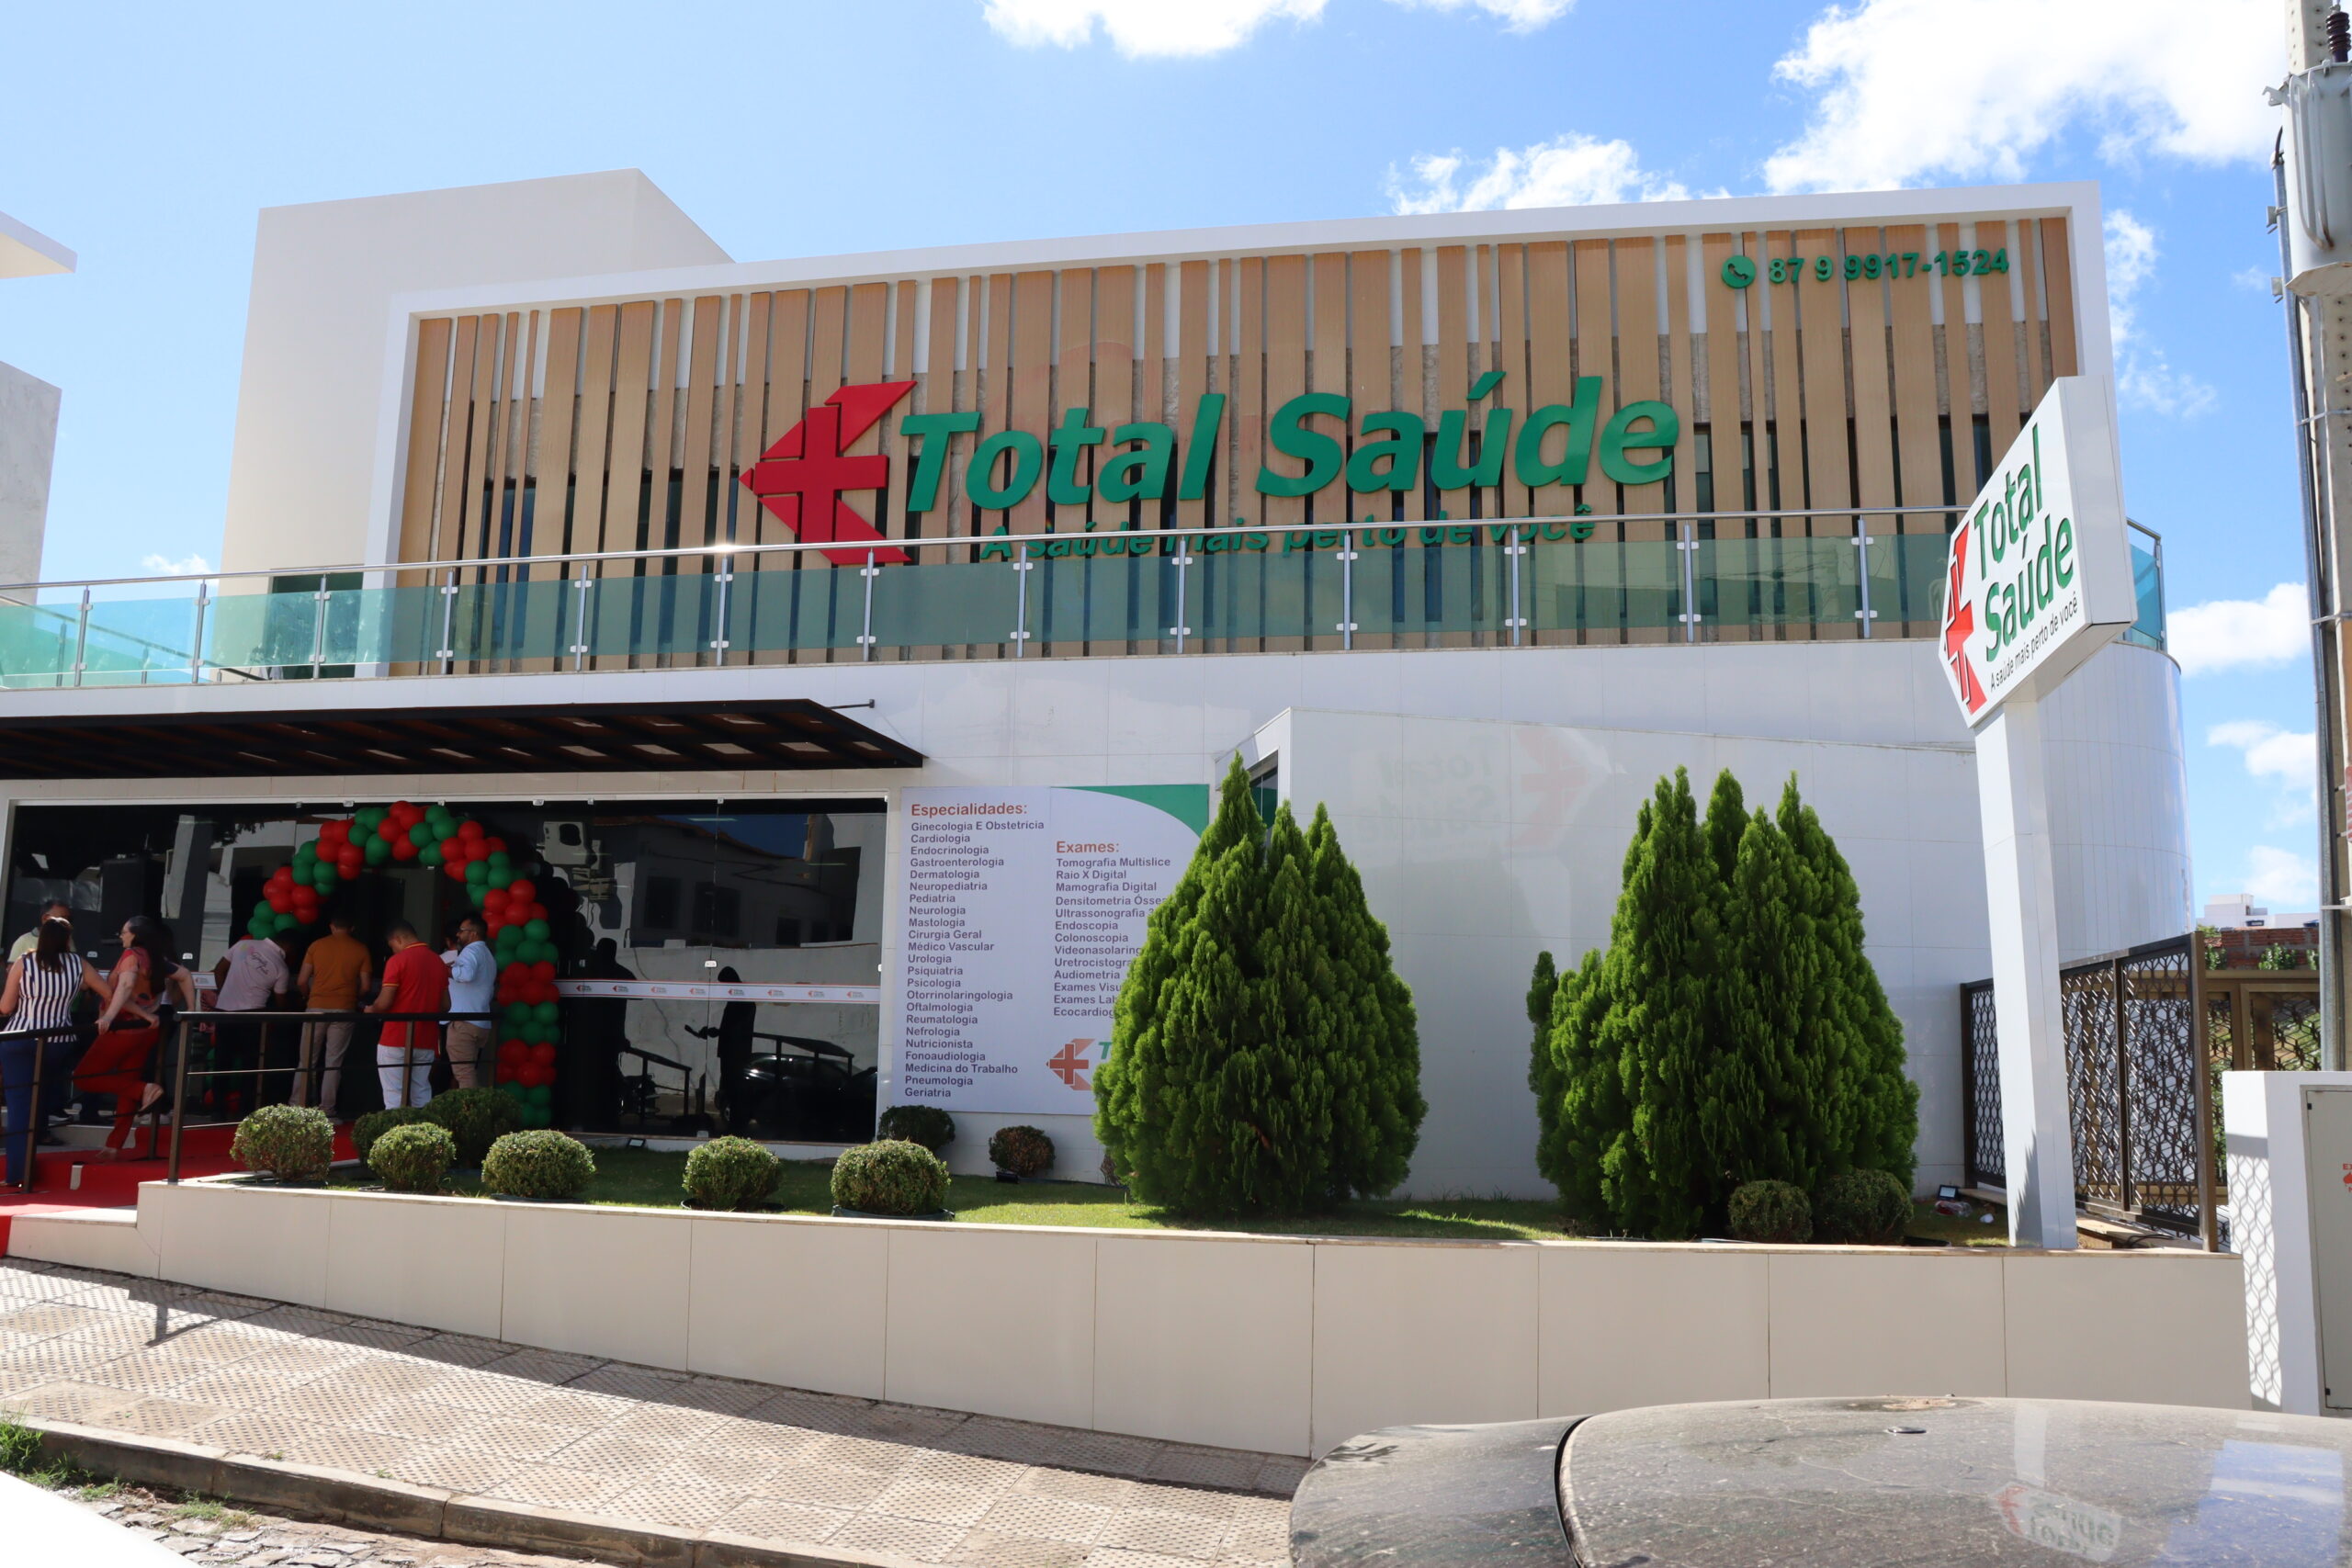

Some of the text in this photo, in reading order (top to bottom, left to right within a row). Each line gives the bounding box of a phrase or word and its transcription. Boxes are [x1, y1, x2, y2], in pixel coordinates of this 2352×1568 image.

[1769, 248, 2009, 284] 87 9 9917-1524
[899, 371, 1679, 513] Total Saúde
[979, 525, 1013, 559] A
[1025, 521, 1155, 558] saúde
[1419, 511, 1473, 545] de
[1487, 503, 1595, 543] você
[1973, 423, 2075, 662] Total Saúde
[1990, 671, 1996, 693] A
[2015, 641, 2030, 670] mais
[2030, 625, 2049, 660] perto
[2050, 613, 2059, 637] de
[2060, 590, 2078, 626] você
[911, 802, 1028, 818] Especialidades:
[911, 822, 973, 833] Ginecologia
[976, 821, 982, 830] E
[910, 834, 970, 844] Cardiologia
[910, 846, 989, 856] Endocrinologia
[1057, 840, 1120, 853] Exames:
[910, 857, 1004, 868] Gastroenterologia
[1057, 857, 1170, 869] Tomografia Multislice
[910, 870, 979, 881] Dermatologia
[1057, 870, 1126, 881] Raio X Digital
[910, 882, 988, 893] Neuropediatria
[1056, 882, 1157, 894] Mamografia Digital
[910, 894, 956, 903] Pediatria
[1056, 897, 1131, 906] Densitometria
[910, 906, 966, 917] Neurologia
[1056, 908, 1145, 919] Ultrassonografia
[909, 918, 965, 929] Mastologia
[1055, 920, 1118, 931] Endoscopia
[909, 930, 982, 941] Cirurgia Geral
[1055, 933, 1128, 944] Colonoscopia
[908, 942, 994, 951] Médico Vascular
[1055, 945, 1141, 956] Videonasolaring
[908, 954, 952, 965] Urologia
[908, 965, 963, 977] Psiquiatria
[1054, 970, 1120, 979] Audiometria
[907, 978, 961, 989] Psicologia
[1054, 982, 1121, 991] Exames Visu
[907, 990, 1012, 1002] Otorrinolaringologia
[1054, 995, 1095, 1004] Exames
[907, 1002, 973, 1014] Oftalmologia
[906, 1014, 978, 1026] Reumatologia
[906, 1026, 960, 1038] Nefrologia
[906, 1039, 973, 1048] Nutricionista
[906, 1051, 986, 1063] Fonoaudiologia
[905, 1063, 1018, 1073] Medicina do Trabalho
[905, 1076, 973, 1088] Pneumologia
[905, 1088, 951, 1097] Geriatria
